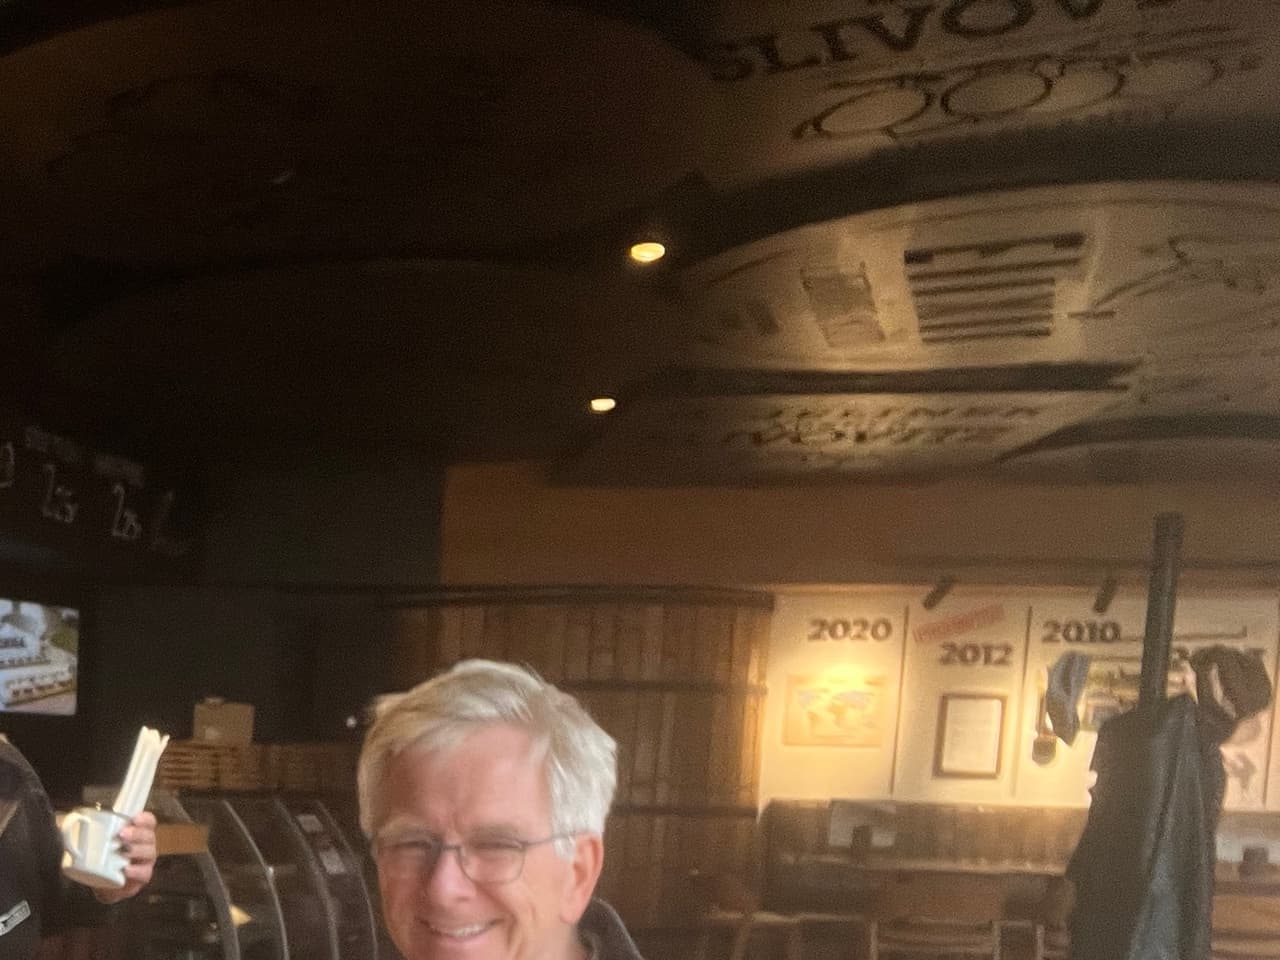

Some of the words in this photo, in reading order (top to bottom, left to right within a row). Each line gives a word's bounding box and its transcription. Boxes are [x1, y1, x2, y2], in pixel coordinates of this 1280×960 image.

[708, 0, 1172, 82] SLIVO
[807, 617, 893, 642] 2020
[939, 643, 1013, 667] 2012
